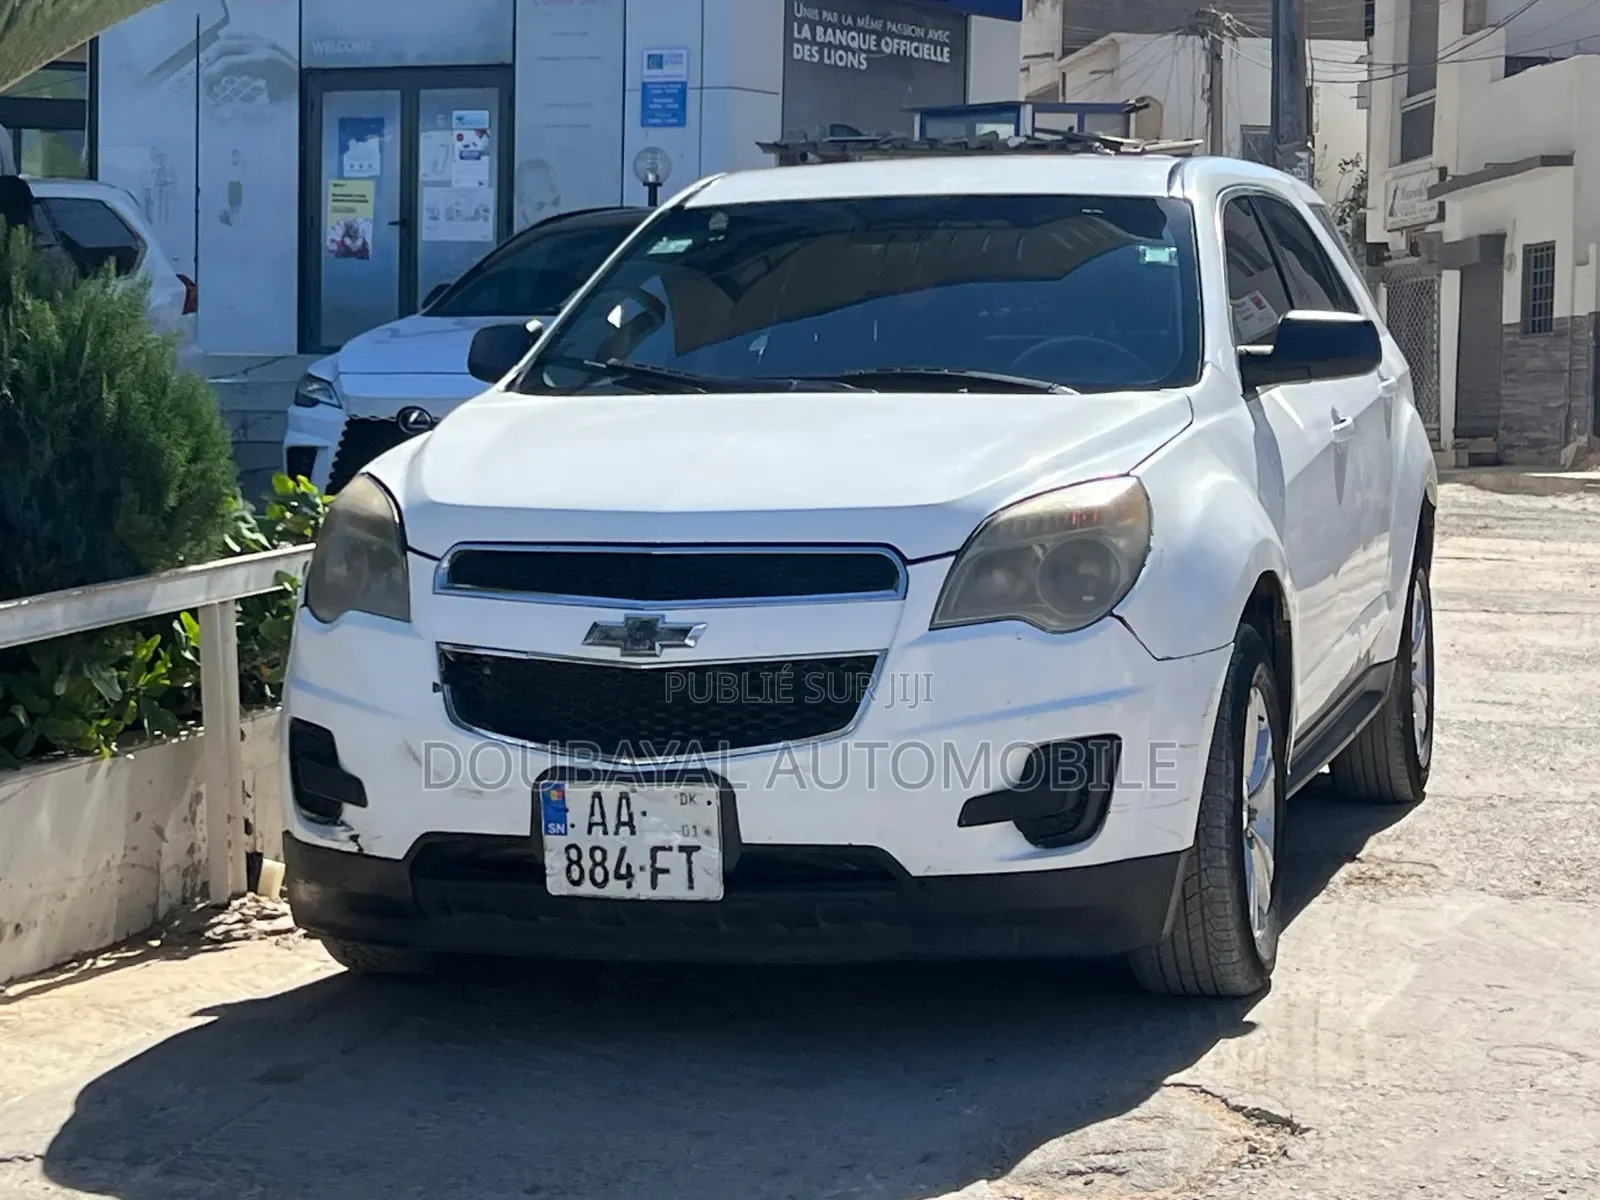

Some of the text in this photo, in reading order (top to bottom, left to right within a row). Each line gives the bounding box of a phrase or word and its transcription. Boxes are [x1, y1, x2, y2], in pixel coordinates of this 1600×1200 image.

[822, 10, 838, 22] PAR
[841, 14, 853, 26] LA
[856, 14, 884, 31] MÊME
[886, 20, 925, 38] PASSION
[926, 29, 950, 43] AVEC
[793, 21, 950, 63] LA BANQUE OFFICIELLE
[792, 43, 868, 70] DES LIONS
[679, 792, 698, 806] DK
[547, 823, 566, 834] SN
